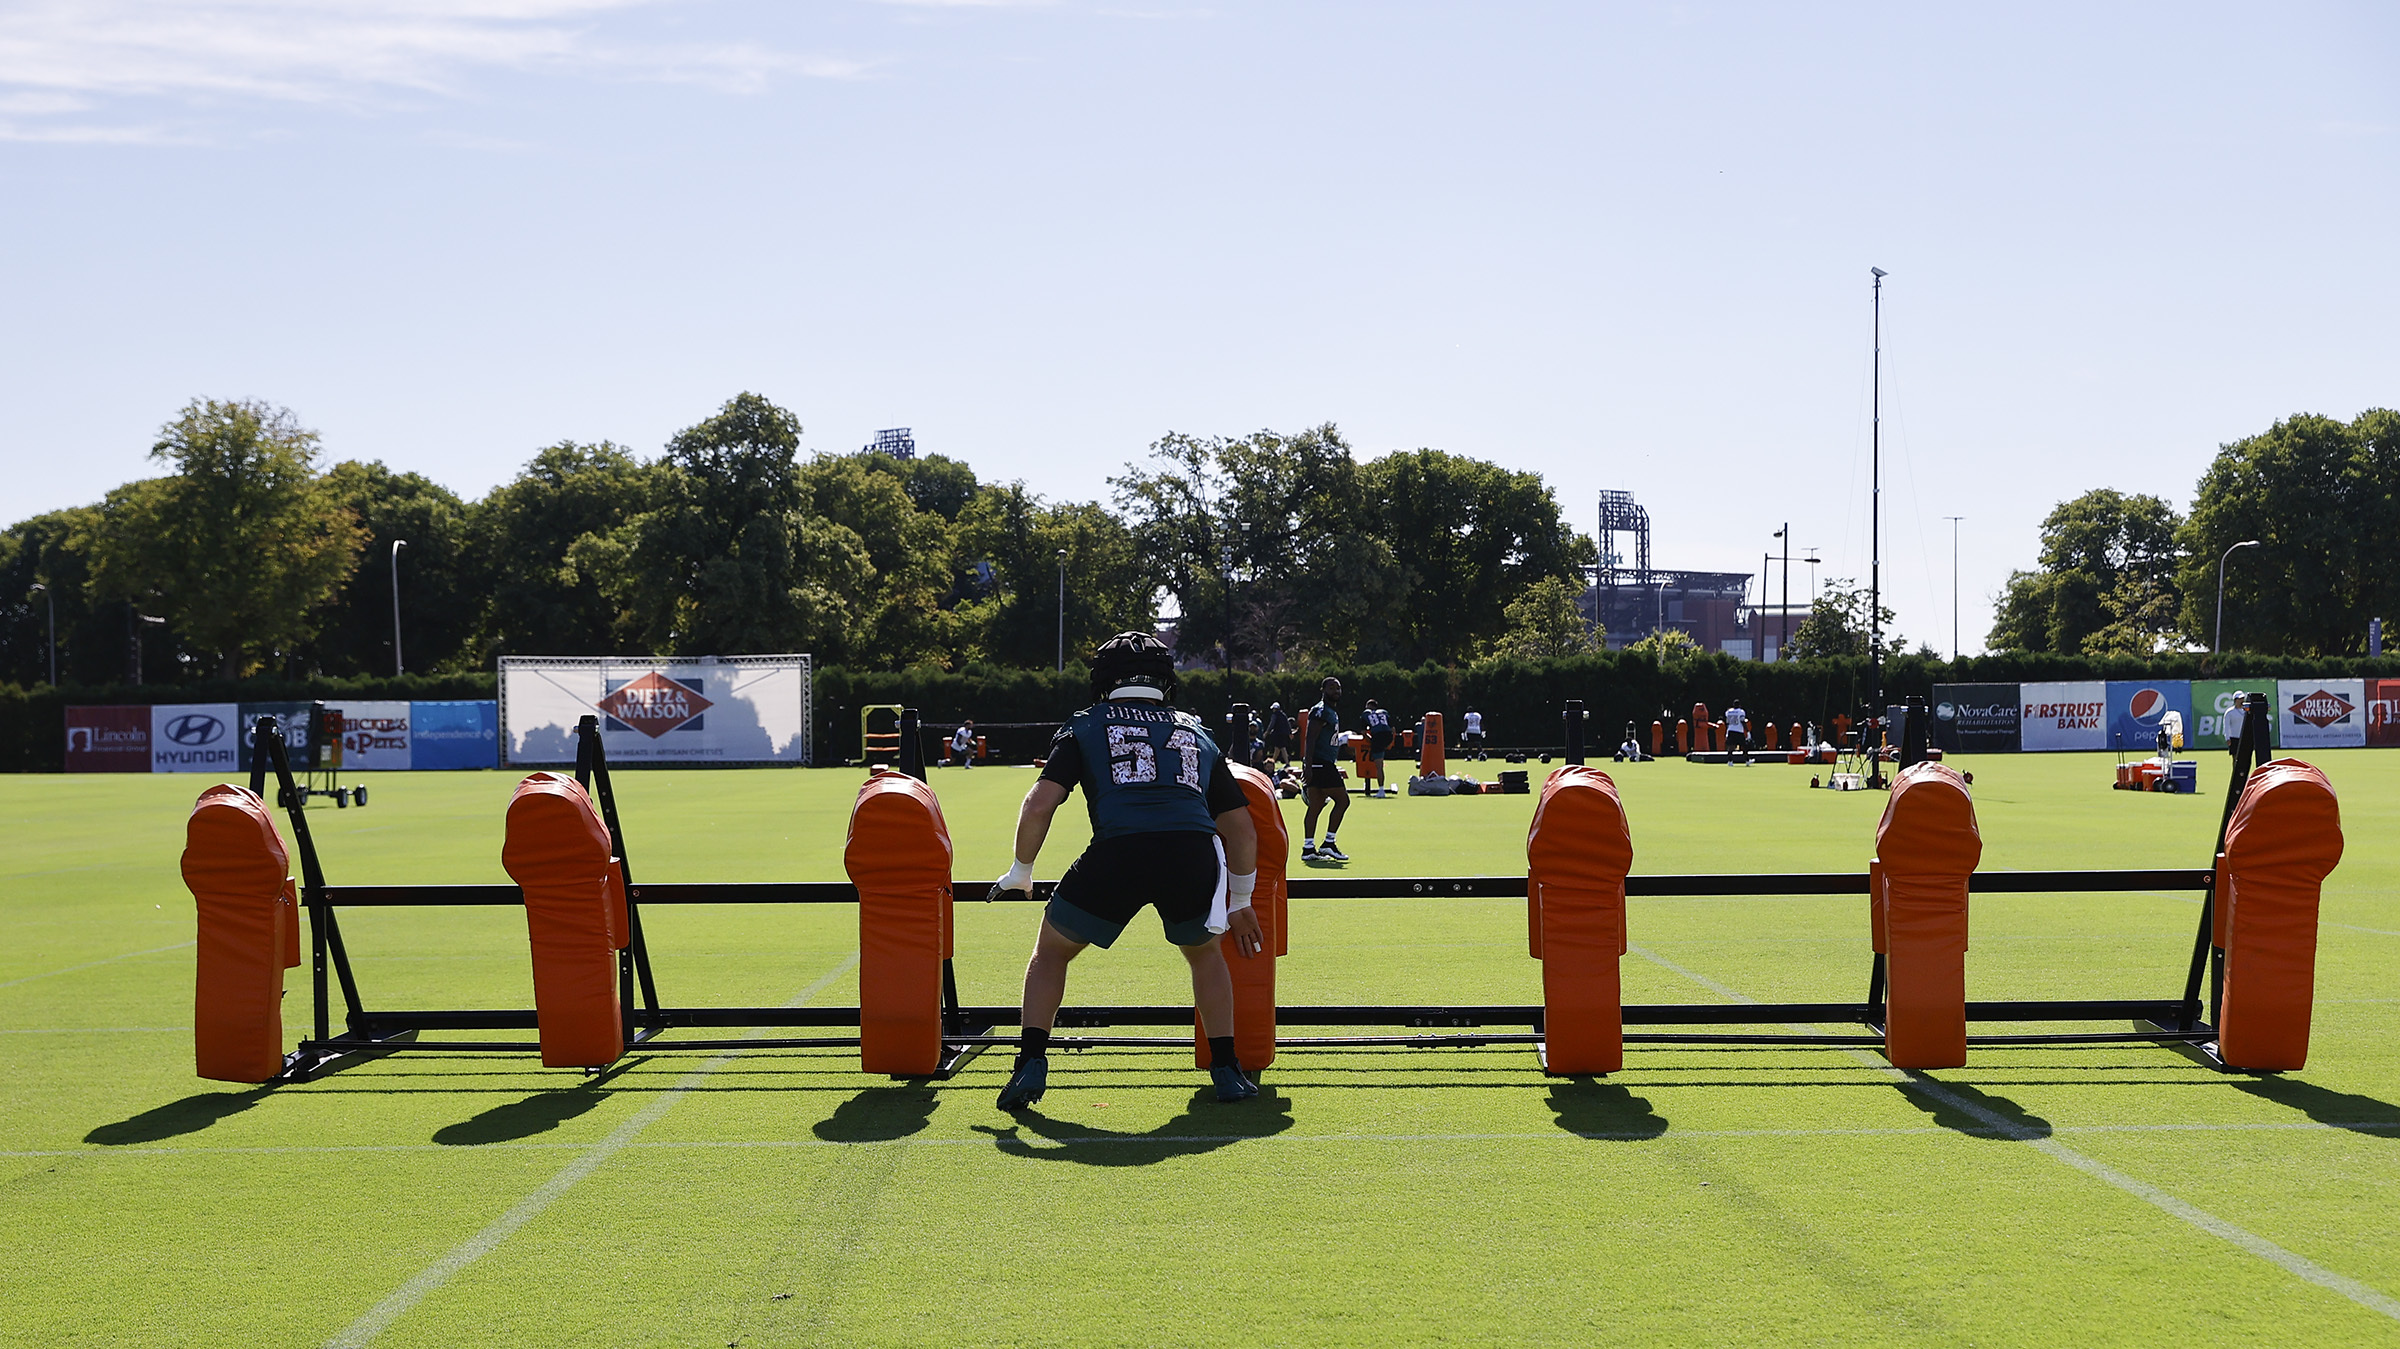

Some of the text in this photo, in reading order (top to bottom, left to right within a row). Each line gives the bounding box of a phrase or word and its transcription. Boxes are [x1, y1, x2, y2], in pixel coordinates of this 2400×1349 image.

[617, 703, 690, 719] WATSON
[1957, 704, 2018, 718] NovaCare
[2300, 707, 2342, 718] WATSON
[244, 713, 287, 728] KS
[342, 718, 408, 733] HICKIE'S
[1368, 713, 1388, 727] 83
[2057, 717, 2099, 730] BANK
[94, 726, 146, 742] Lincoln
[2134, 731, 2157, 742] pep
[156, 750, 235, 764] HYUNDAI
[1106, 724, 1203, 794] 51
